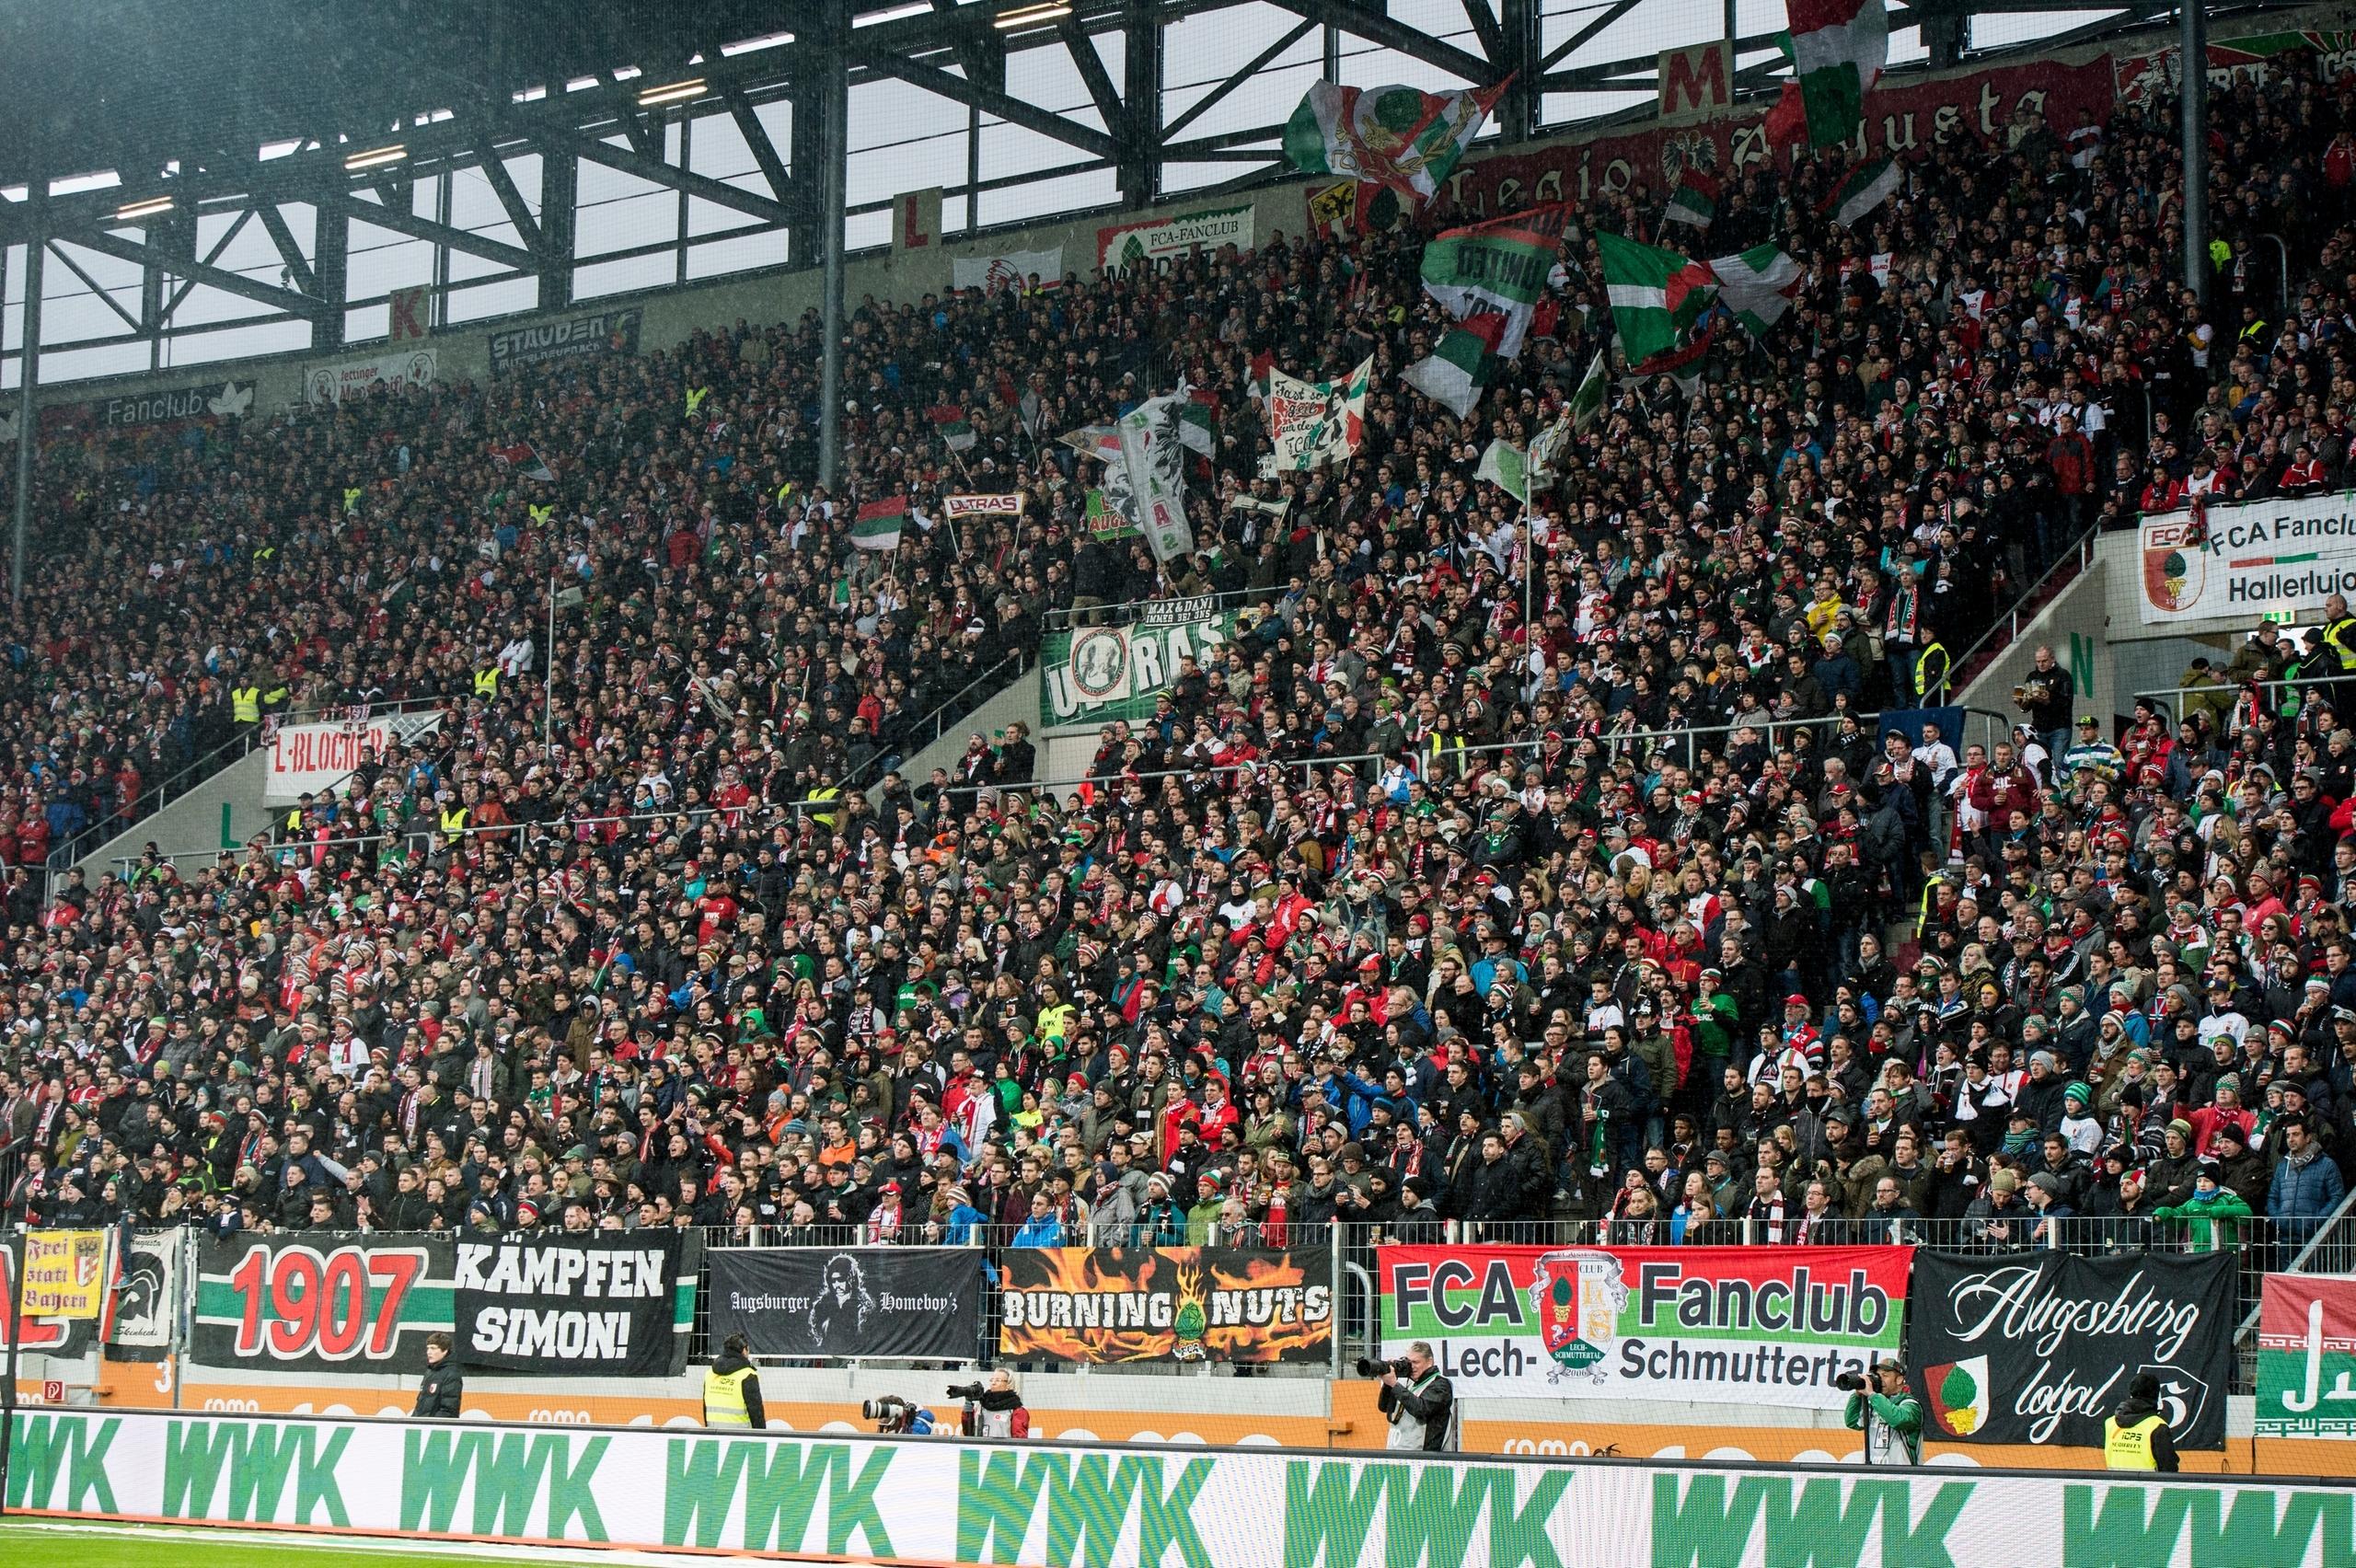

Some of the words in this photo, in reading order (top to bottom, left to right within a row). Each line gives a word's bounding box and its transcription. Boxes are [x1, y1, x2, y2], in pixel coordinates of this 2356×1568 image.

[1662, 46, 1728, 114] M
[905, 196, 928, 249] L
[1150, 221, 1239, 246] FCA-FANCLUB
[392, 290, 422, 340] K
[493, 317, 605, 358] STAUDEN
[108, 391, 202, 425] Fanclub
[1275, 380, 1304, 399] Fast
[1288, 402, 1319, 417] geil
[950, 497, 1016, 511] ULTRAS
[2210, 522, 2268, 556] FCA
[1146, 614, 1173, 624] IMMER
[1048, 614, 1224, 718] URAS
[2071, 632, 2093, 698] N
[221, 802, 241, 848] L
[29, 1238, 68, 1262] Frei
[456, 1231, 664, 1297] KÄMPFEN
[1579, 1265, 1603, 1274] CLUB
[24, 1290, 87, 1311] Bayern
[233, 1245, 428, 1359] 1907
[731, 1292, 811, 1313] Augsburger
[1003, 1290, 1172, 1328] BURNING
[1211, 1285, 1331, 1325] NUTS
[1393, 1261, 1524, 1329] FCA
[1640, 1262, 1888, 1337] Fanclub
[1945, 1262, 2200, 1363] Augsburg
[472, 1307, 630, 1359] SIMON!
[1554, 1351, 1601, 1359] SCHMUTTERTAL
[155, 1359, 173, 1393] 3
[1442, 1339, 1537, 1378] Lech-
[1566, 1369, 1587, 1378] 2006
[162, 1420, 355, 1528] WWK
[399, 1429, 612, 1542] WWK
[664, 1438, 898, 1559] WWK
[955, 1449, 1217, 1568] WWK
[1285, 1459, 1575, 1568] WWK
[1652, 1472, 1976, 1568] WWK
